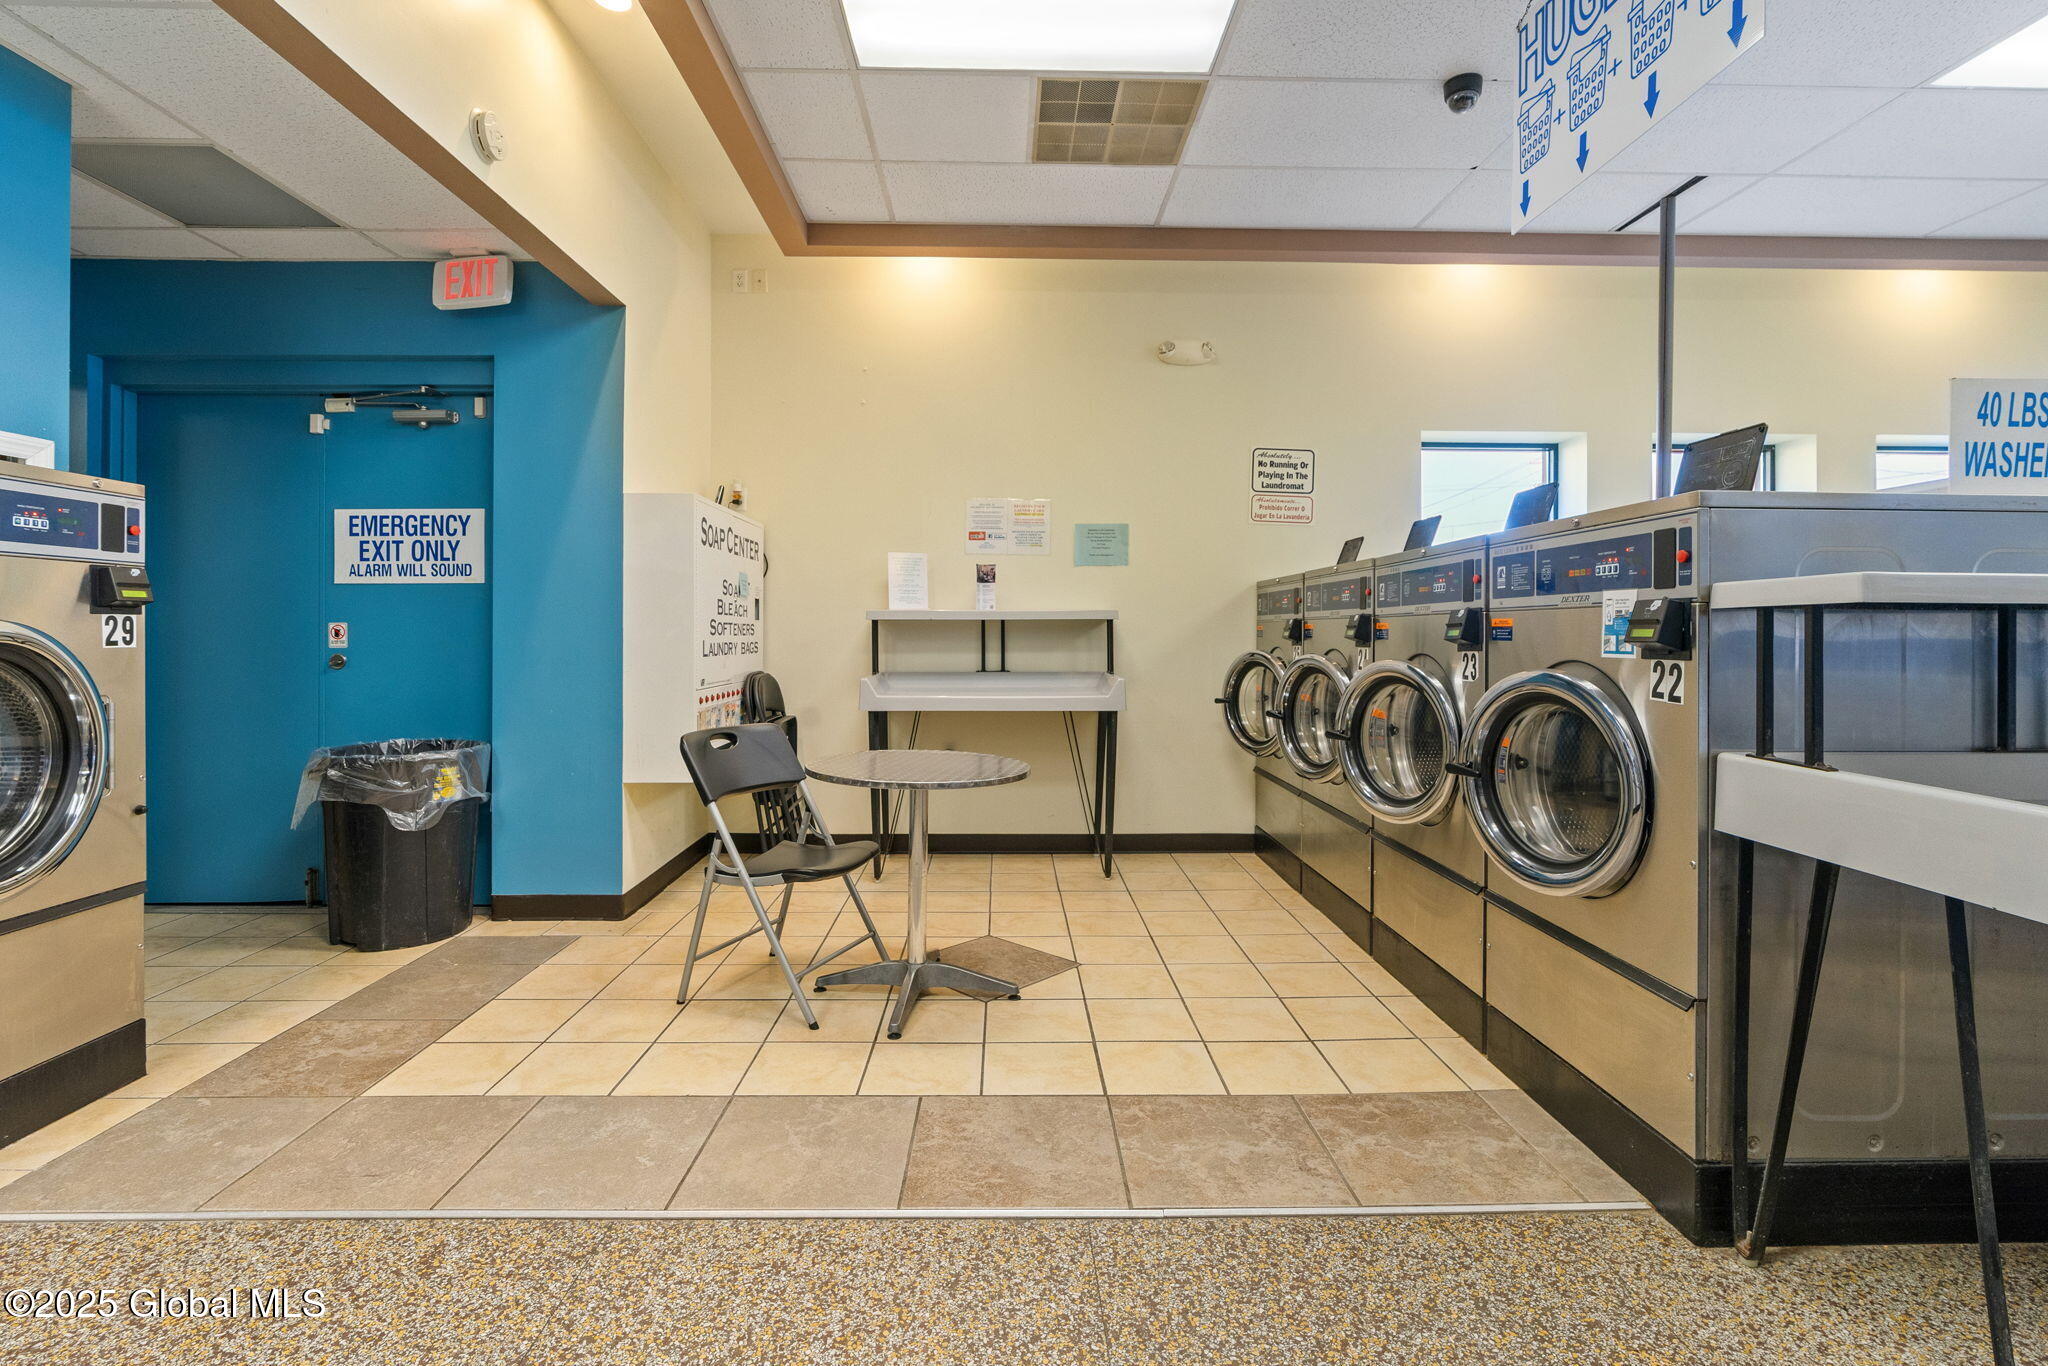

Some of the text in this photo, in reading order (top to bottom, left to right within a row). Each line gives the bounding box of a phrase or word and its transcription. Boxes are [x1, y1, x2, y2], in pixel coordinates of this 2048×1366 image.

[1519, 0, 1617, 97] HUG
[444, 258, 498, 300] EXIT
[1977, 391, 2002, 427] 40
[1258, 460, 1309, 470] No Running Or
[1965, 441, 2048, 478] WASHE
[1258, 471, 1285, 480] Playing
[1295, 472, 1309, 480] The
[1261, 481, 1304, 490] Laundromat
[349, 515, 471, 536] EMERGENCY
[701, 516, 759, 562] SOAP CENTER
[359, 540, 460, 562] EXIT ONLY
[349, 563, 472, 577] ALARM WILL SOUND
[717, 599, 748, 617] BLEACH
[1561, 594, 1590, 603] DEXTER
[104, 615, 135, 647] 29
[709, 619, 755, 636] SOFTENERS
[703, 640, 758, 657] LAUNDRY BAGS
[1462, 652, 1477, 682] 23
[1651, 660, 1683, 704] 22
